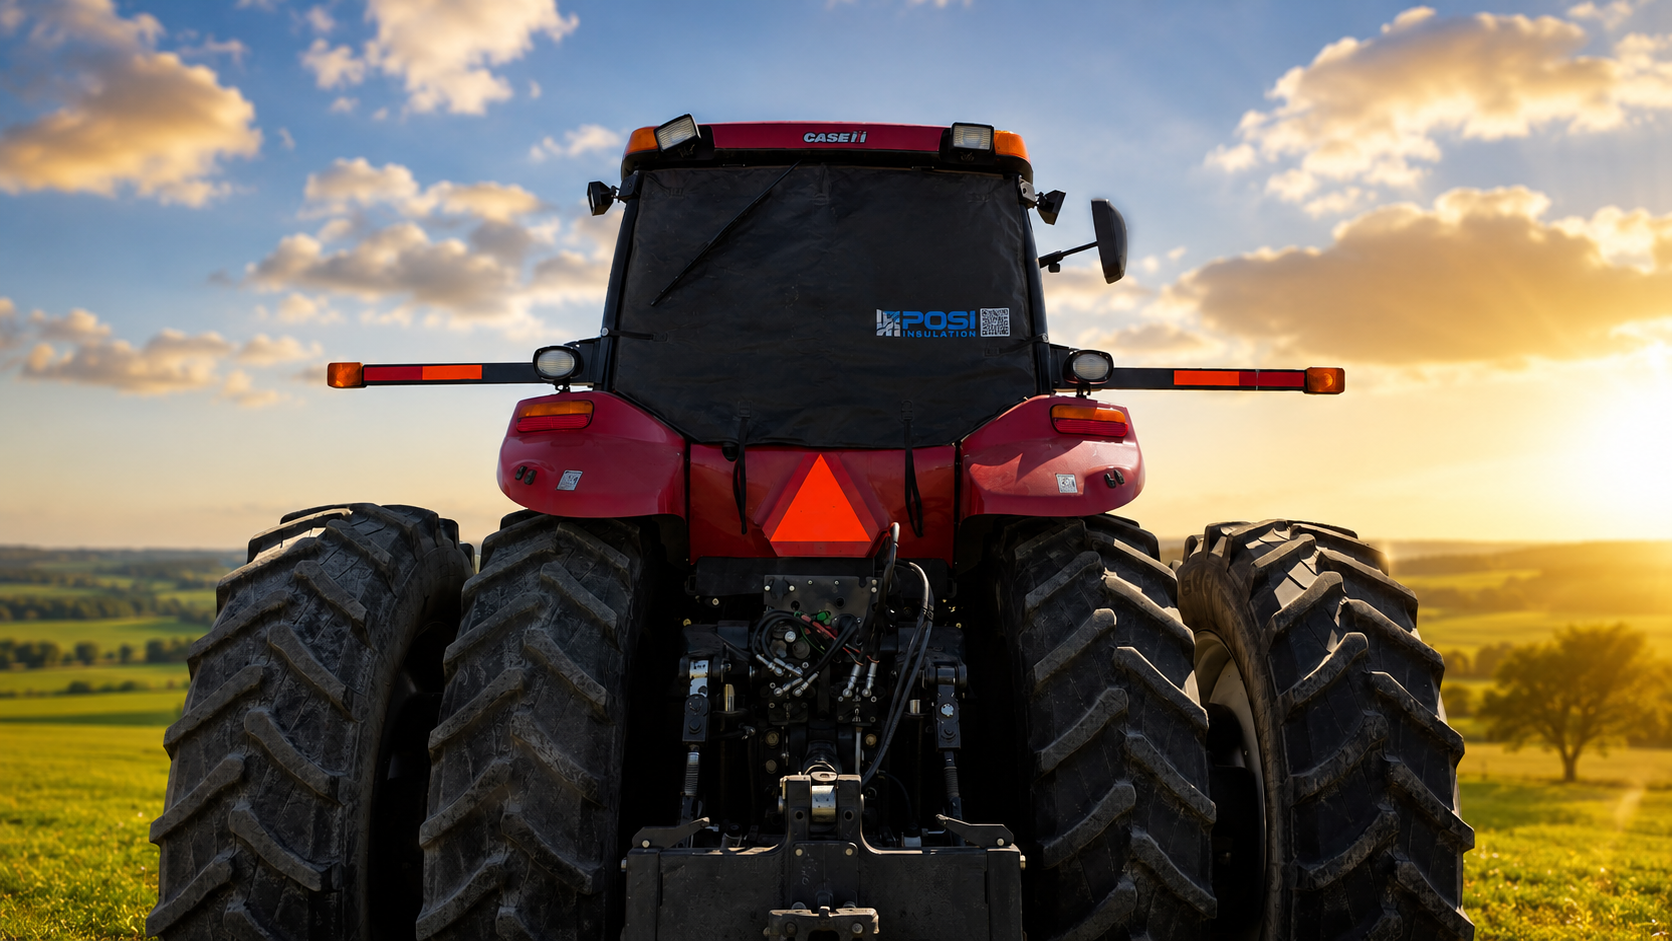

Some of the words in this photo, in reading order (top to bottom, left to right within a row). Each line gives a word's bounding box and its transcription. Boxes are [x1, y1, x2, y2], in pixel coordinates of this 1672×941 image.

[803, 132, 850, 143] CASE
[902, 310, 976, 330] POSI
[902, 330, 976, 338] INSULATION
